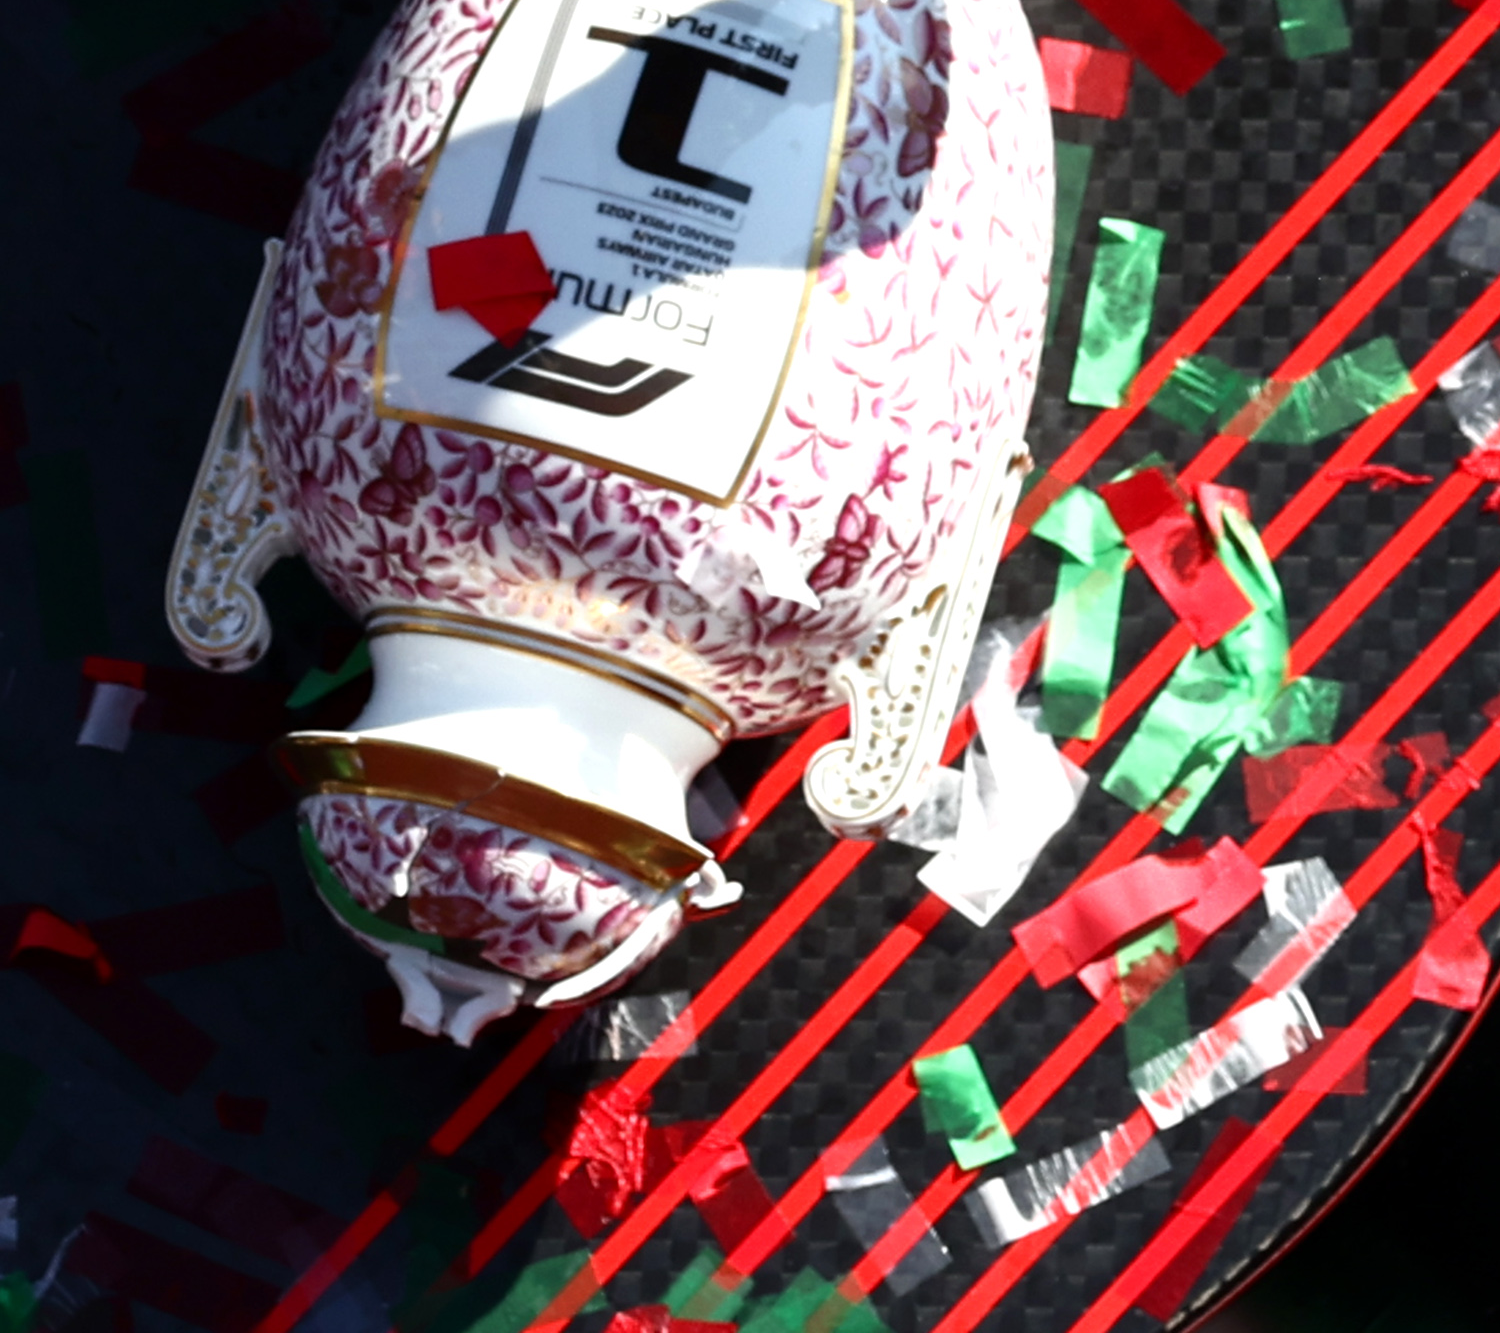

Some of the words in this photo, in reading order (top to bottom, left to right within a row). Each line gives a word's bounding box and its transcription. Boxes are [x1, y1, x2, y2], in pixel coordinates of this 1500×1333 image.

[634, 5, 716, 39] PLACE
[716, 26, 799, 71] FIRST
[586, 25, 790, 205] 1
[596, 202, 637, 224] 2023
[652, 186, 736, 222] BUDAPEST
[638, 211, 676, 234] PRIX
[677, 221, 736, 252] GRAND
[597, 237, 671, 272] AIRWAYS
[631, 230, 732, 267] HUNGARIAN
